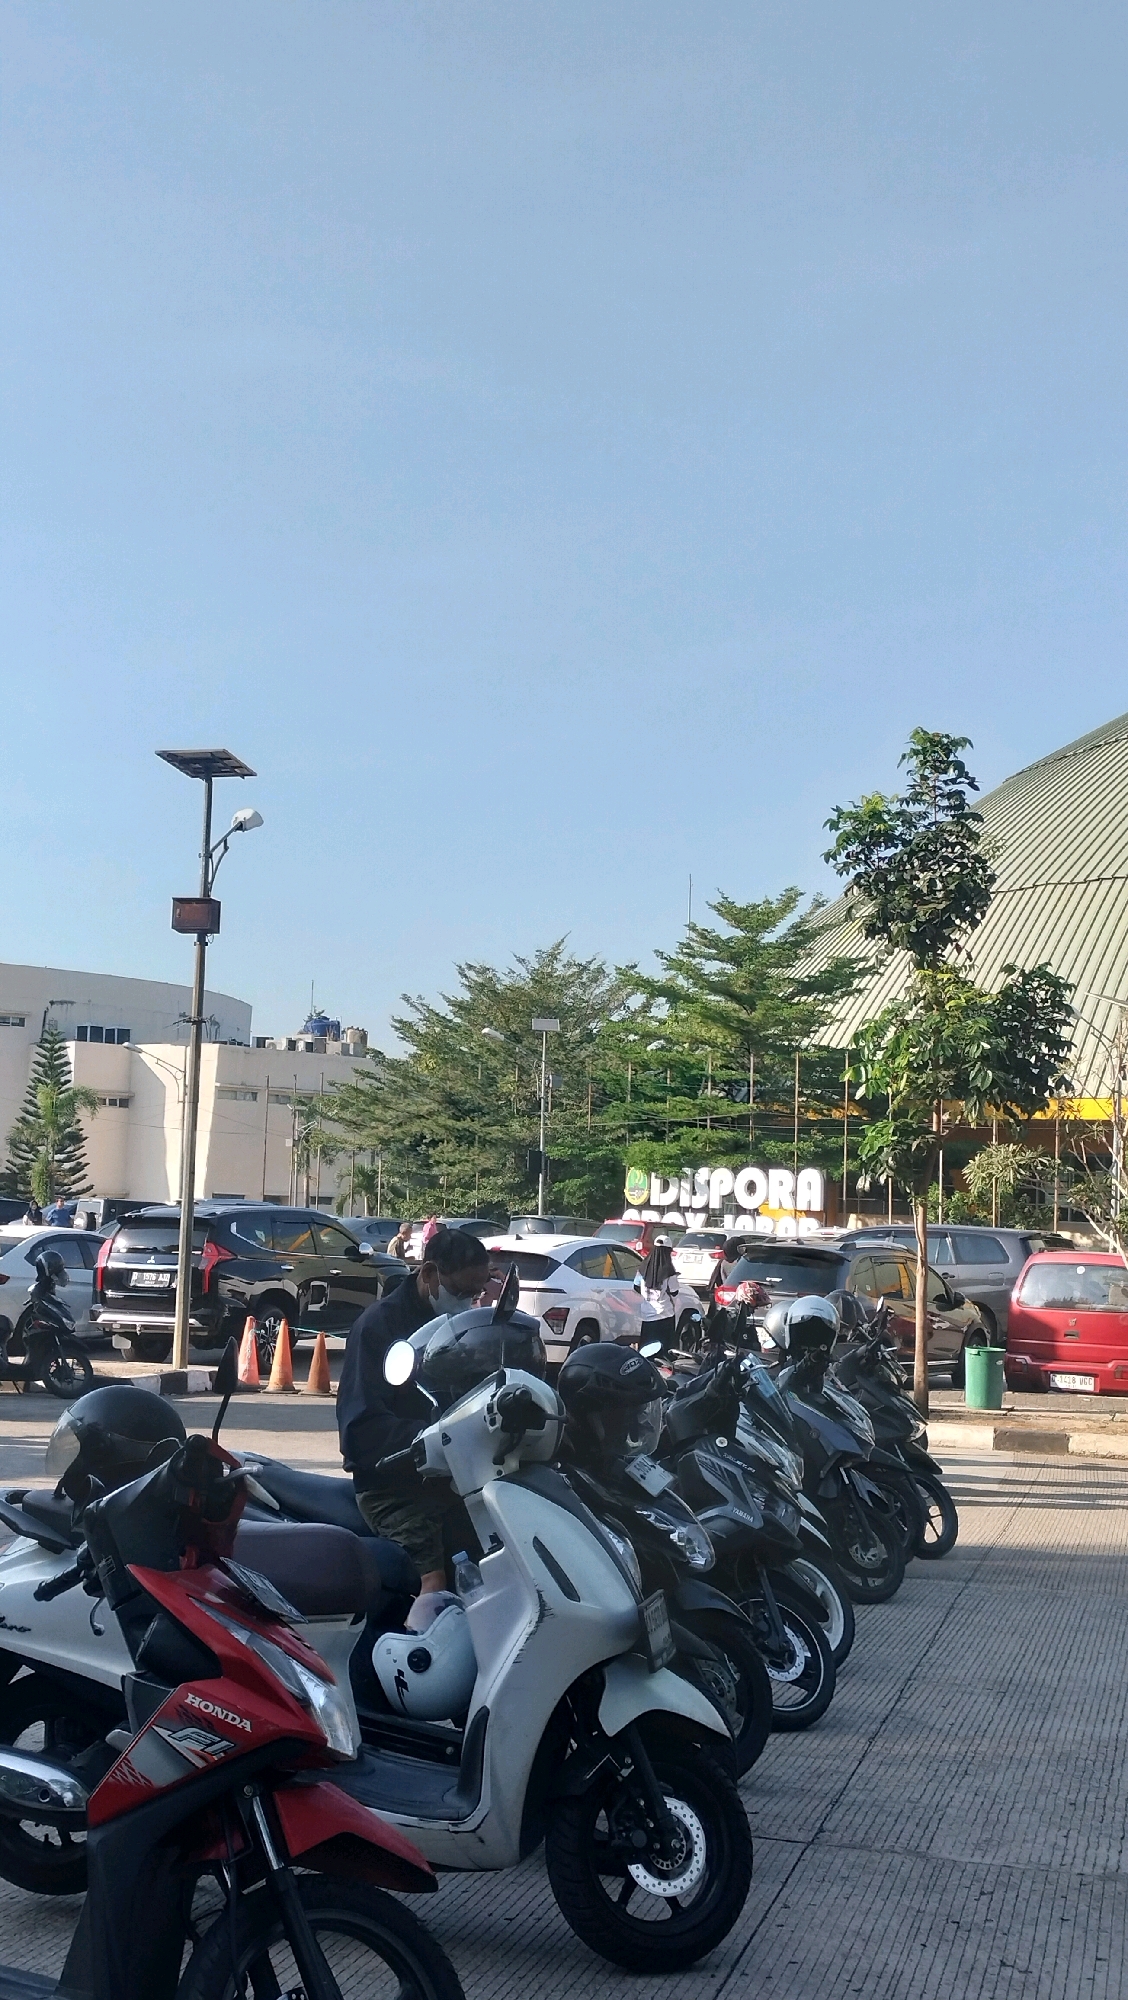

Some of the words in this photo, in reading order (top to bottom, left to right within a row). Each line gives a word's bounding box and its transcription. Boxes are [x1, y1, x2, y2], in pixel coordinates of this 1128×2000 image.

[650, 1167, 825, 1212] DISPORA
[732, 1506, 754, 1523] YAMAHA
[184, 1692, 252, 1733] HONDA
